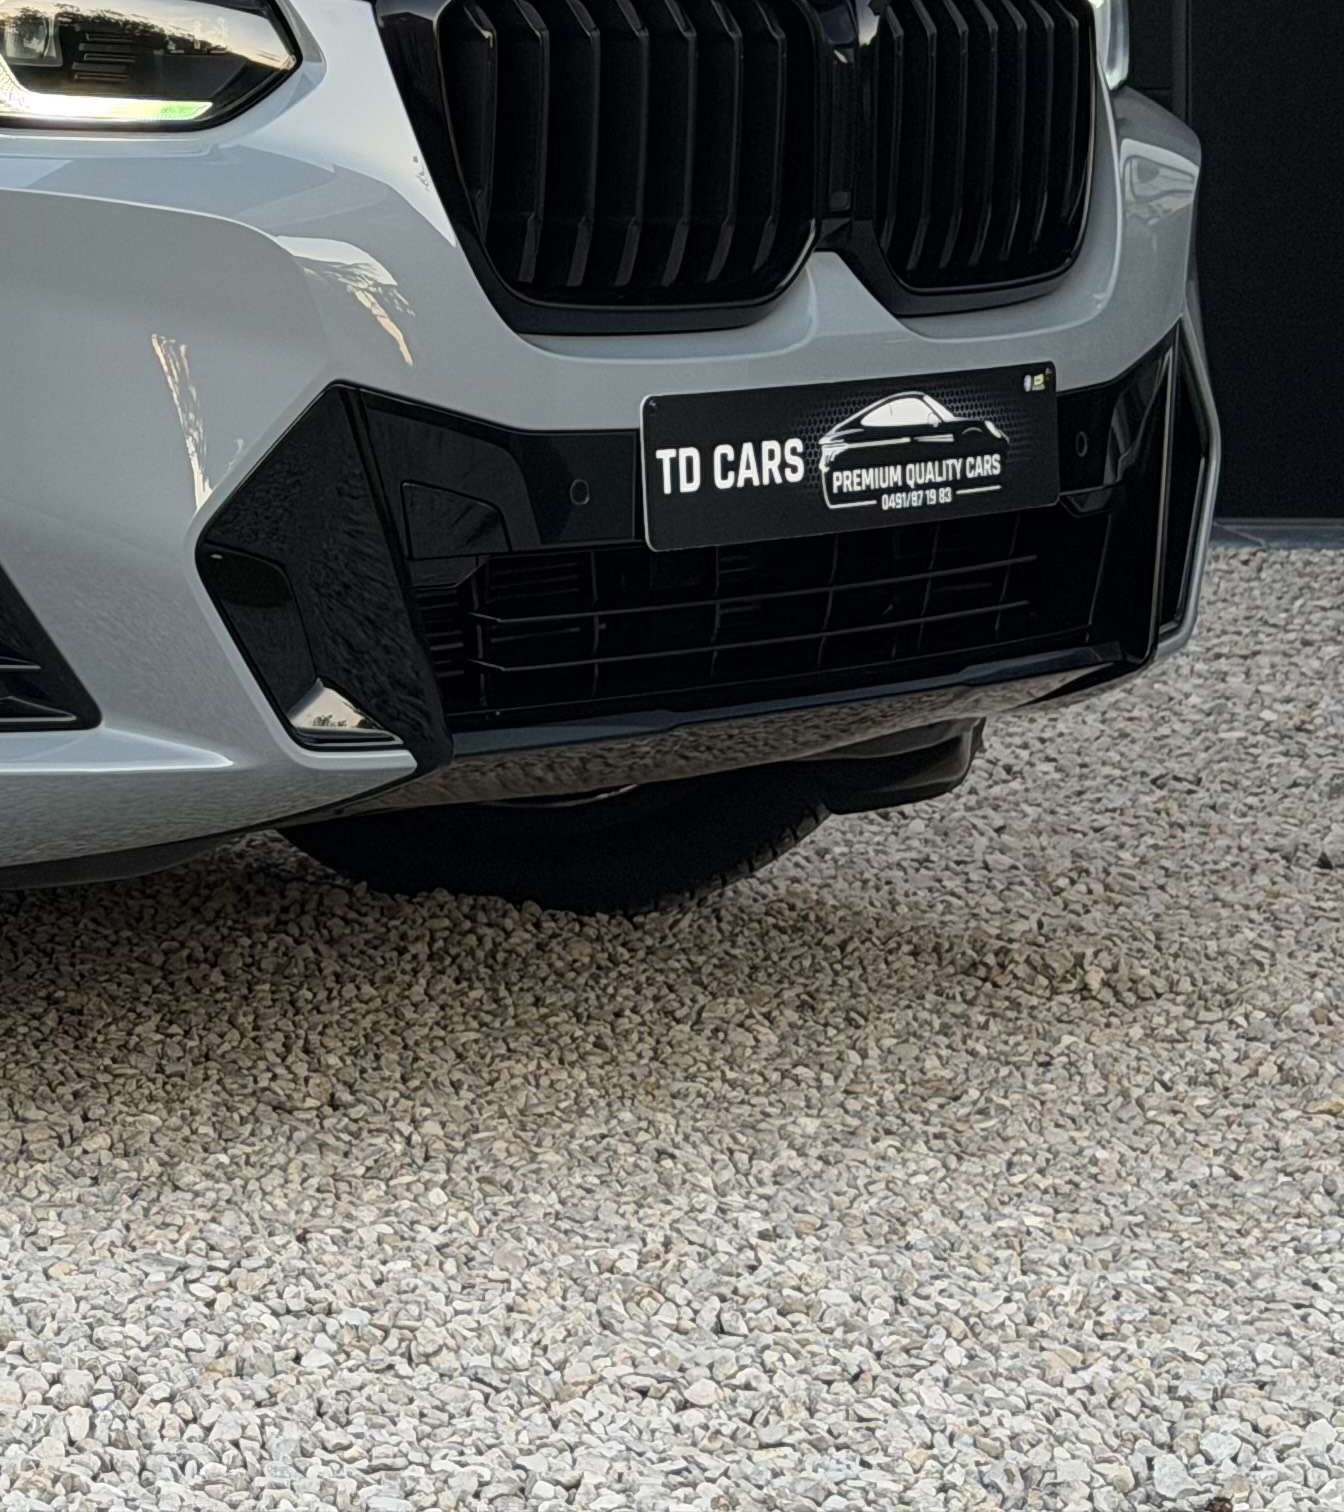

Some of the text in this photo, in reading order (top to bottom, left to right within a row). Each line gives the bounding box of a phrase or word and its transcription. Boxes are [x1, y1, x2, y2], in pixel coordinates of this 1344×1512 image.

[655, 437, 805, 495] TD CARS
[832, 453, 1001, 494] PREMIUM QUALITY CARS
[924, 488, 937, 505] 19
[938, 486, 953, 504] 83
